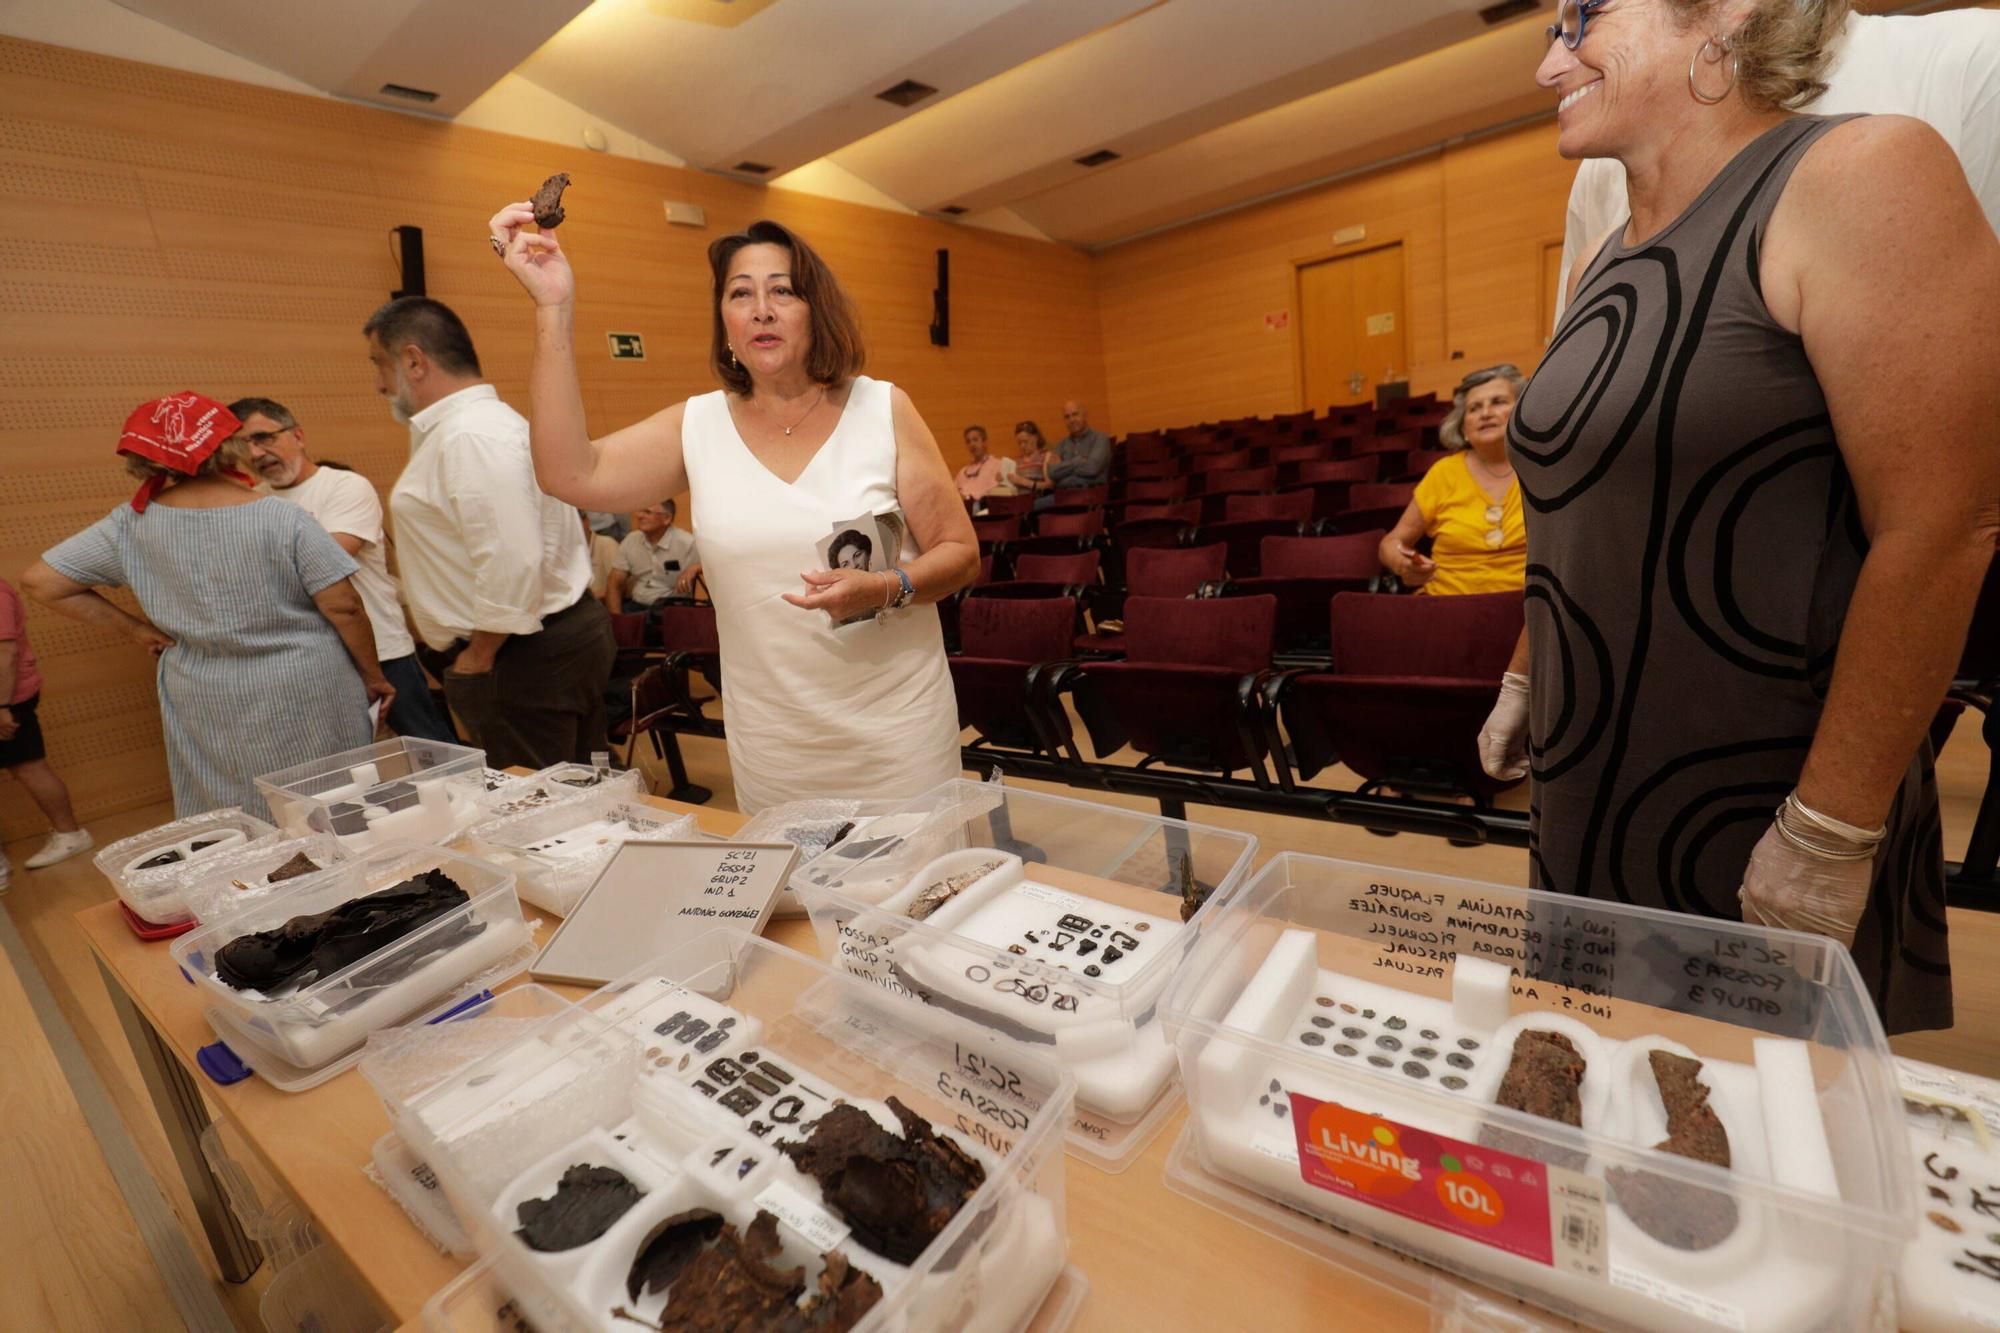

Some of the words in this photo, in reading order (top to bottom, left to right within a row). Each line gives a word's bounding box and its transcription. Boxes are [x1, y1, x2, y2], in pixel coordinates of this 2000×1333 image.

[725, 850, 757, 861] SC'21
[710, 874, 740, 884] GRUP
[739, 876, 748, 885] 2
[835, 919, 878, 948] FOSSA
[841, 941, 879, 967] GRUP
[1321, 1127, 1422, 1182] Living
[1444, 1180, 1496, 1216] 10L
